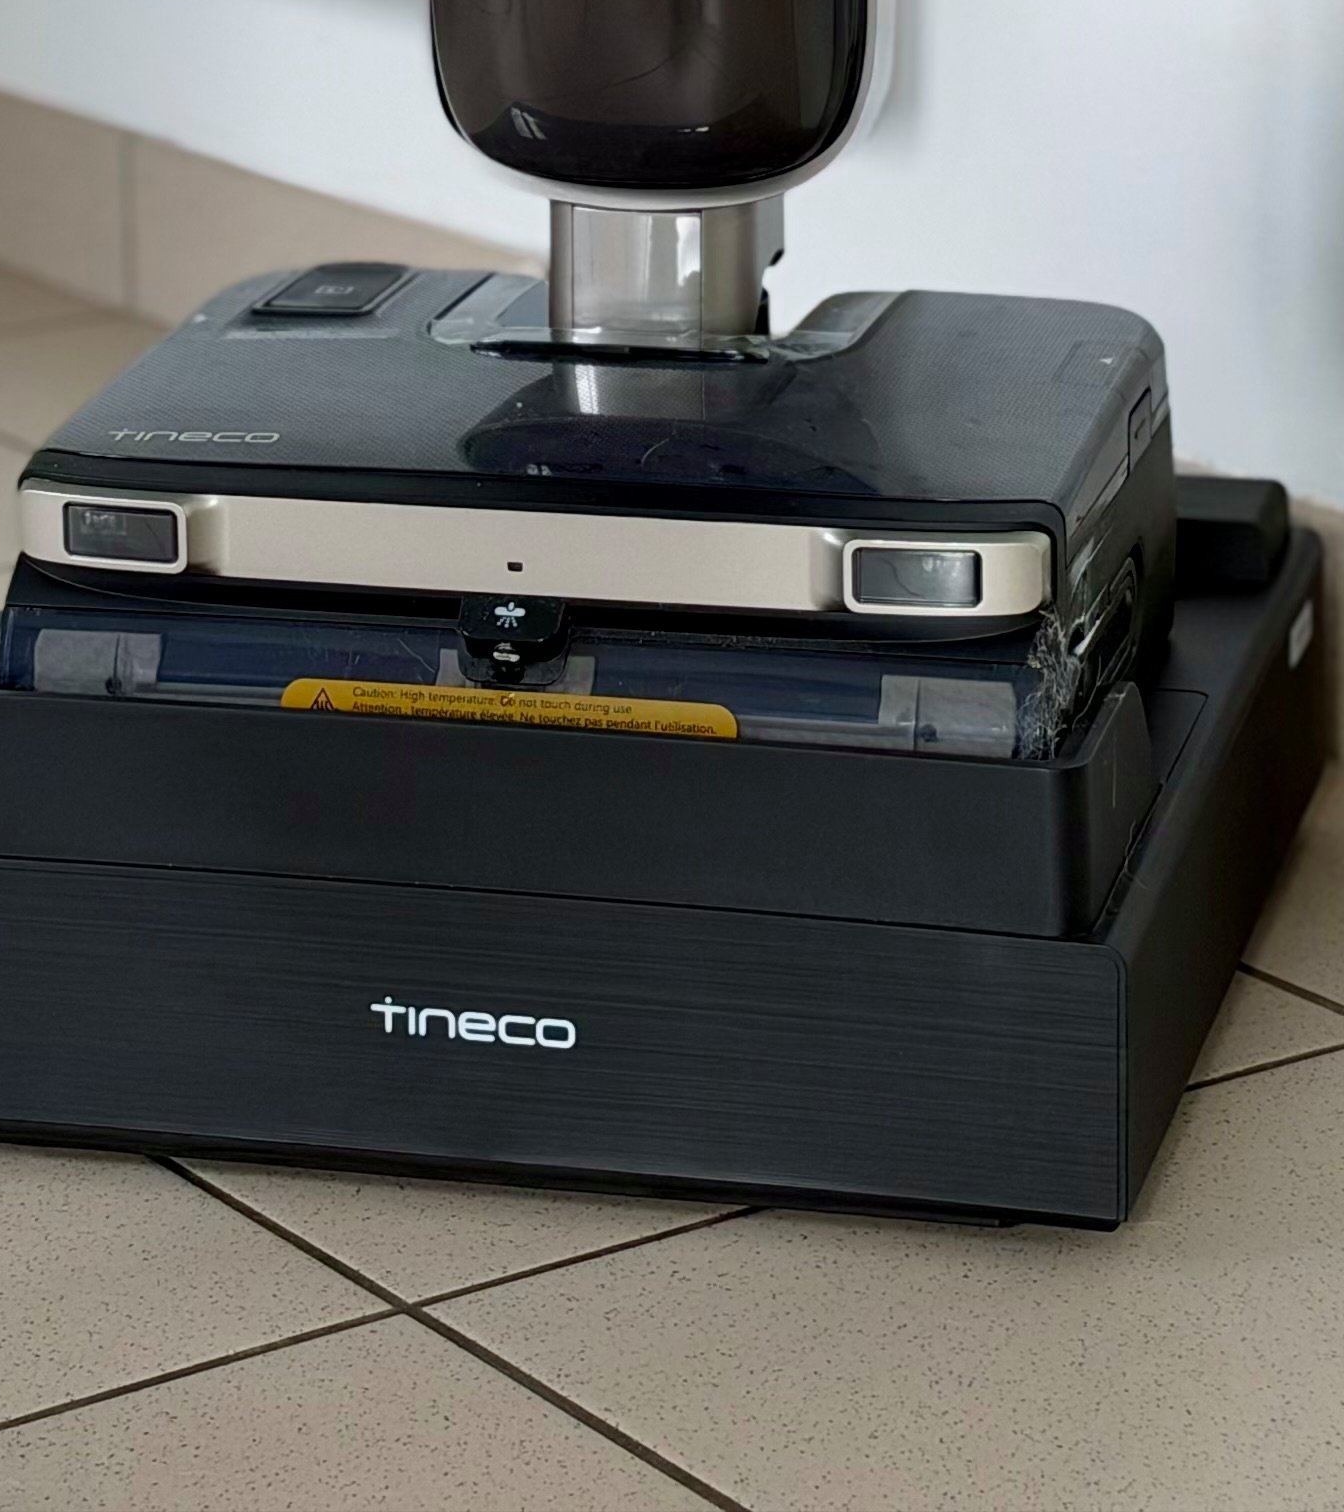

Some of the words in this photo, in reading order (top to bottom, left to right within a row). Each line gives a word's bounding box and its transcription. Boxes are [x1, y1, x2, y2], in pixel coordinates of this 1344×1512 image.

[401, 689, 425, 703] High
[500, 695, 516, 707] Do
[519, 698, 537, 708] not
[541, 699, 571, 709] touch
[575, 702, 610, 715] during
[613, 705, 632, 714] use
[520, 712, 536, 723] Ne
[539, 713, 582, 727] touchez
[585, 718, 602, 729] pas
[606, 718, 652, 730] pendant
[655, 721, 717, 735] l'utilisation.
